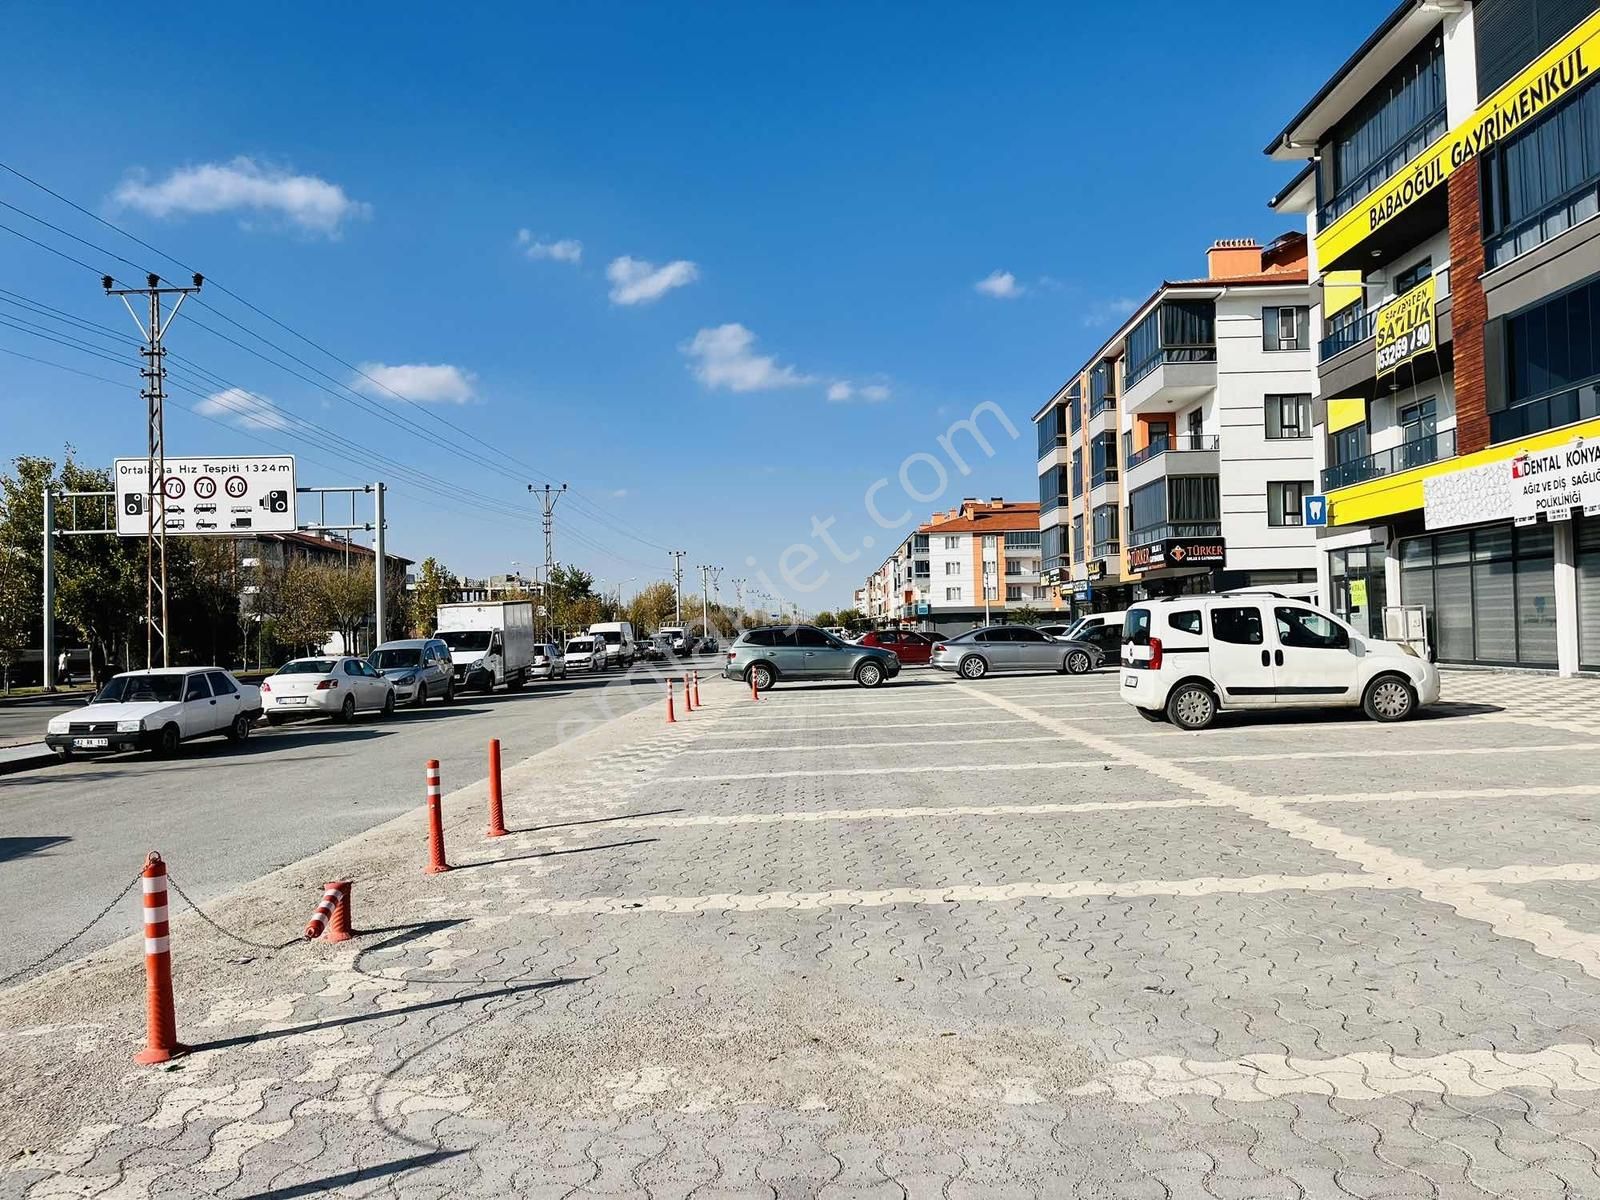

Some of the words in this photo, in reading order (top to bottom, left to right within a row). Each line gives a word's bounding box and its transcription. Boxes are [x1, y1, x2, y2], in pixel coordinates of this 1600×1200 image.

[1369, 158, 1445, 232] BABAOĞUL
[1451, 47, 1589, 168] GAYRİMENKUL
[1523, 455, 1561, 476] DENTAL
[1566, 445, 1600, 467] KONYA
[179, 464, 197, 474] Hız
[203, 463, 240, 475] Tespiti
[167, 482, 182, 494] 70
[198, 482, 213, 494] 70
[229, 482, 244, 493] 60
[1523, 482, 1540, 496] AĞIZ
[1542, 481, 1552, 492] VE
[1553, 477, 1567, 491] DİŞ
[1536, 489, 1582, 509] POLİKLİNİĞİ
[1186, 544, 1224, 556] TÜRKER
